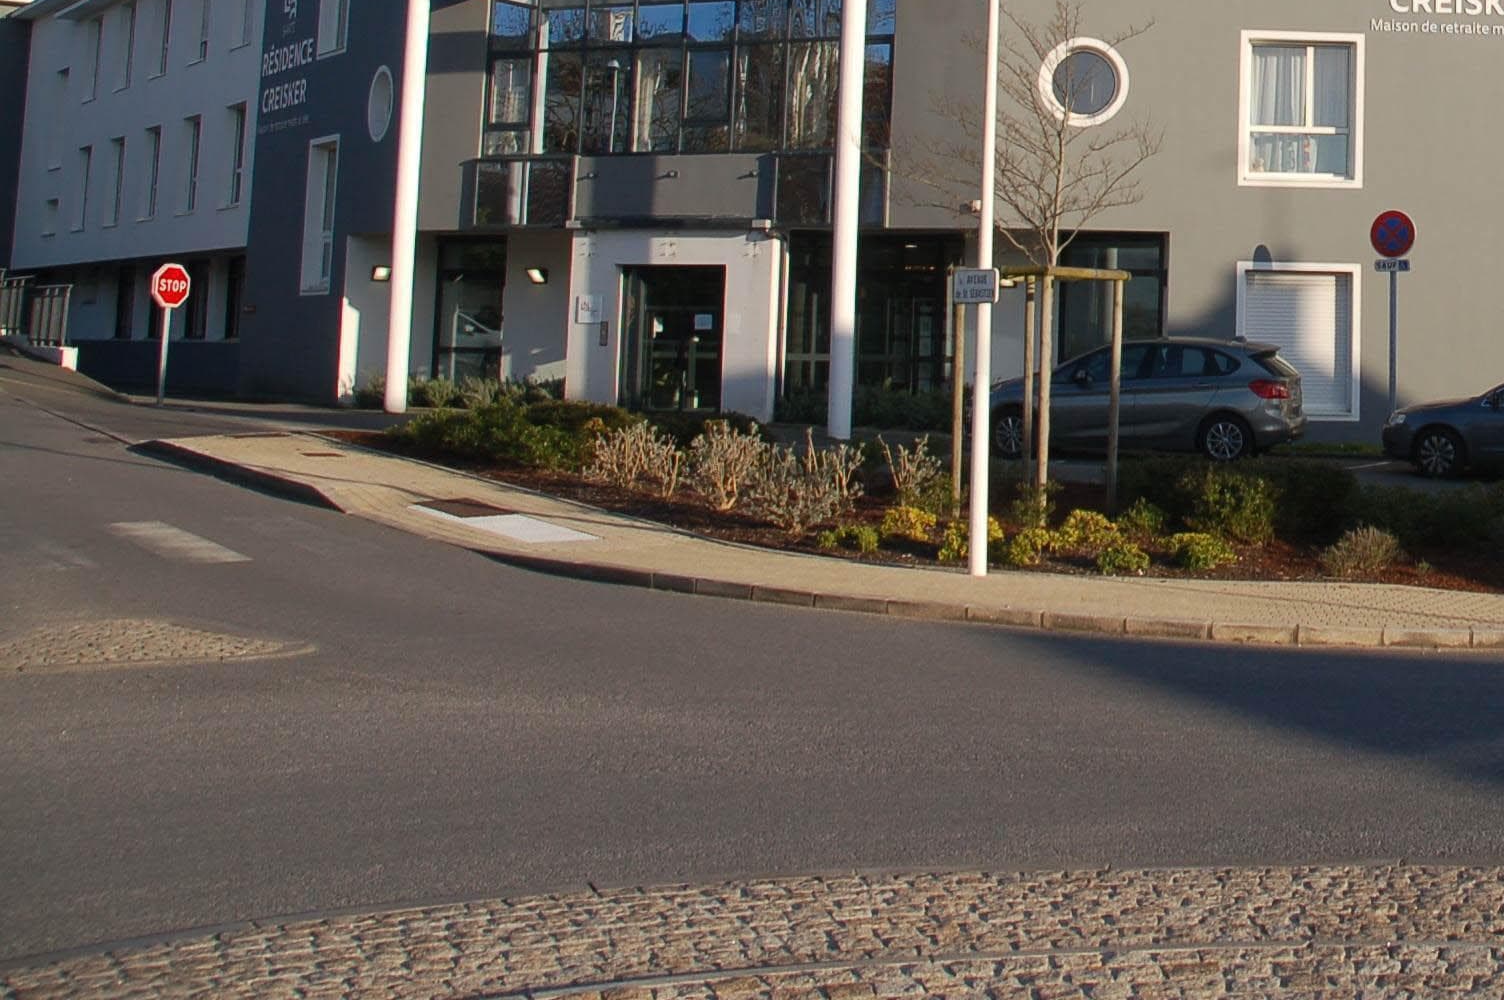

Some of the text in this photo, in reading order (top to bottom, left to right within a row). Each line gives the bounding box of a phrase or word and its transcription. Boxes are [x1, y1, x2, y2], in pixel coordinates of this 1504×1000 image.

[1370, 18, 1419, 33] Maison
[1421, 20, 1437, 33] de
[1440, 21, 1490, 35] retraite
[262, 38, 314, 77] RÉSIDENCE
[262, 78, 307, 113] CREISKER
[159, 278, 187, 293] STOP
